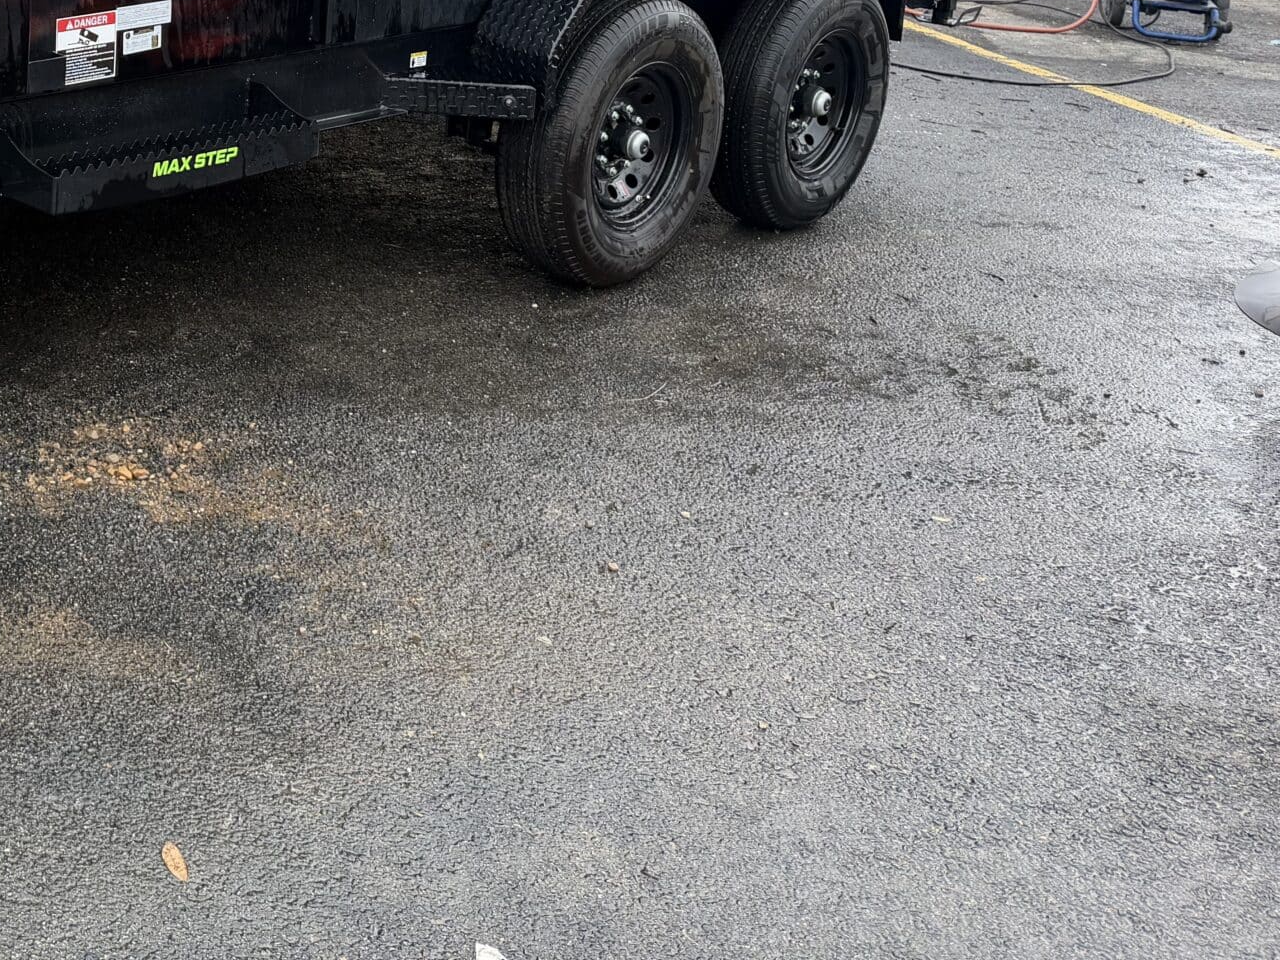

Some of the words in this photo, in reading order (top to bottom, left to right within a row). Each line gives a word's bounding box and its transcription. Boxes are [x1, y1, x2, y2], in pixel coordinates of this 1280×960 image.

[73, 15, 109, 29] DANGER
[152, 155, 193, 178] MAX
[193, 146, 239, 169] STEP
